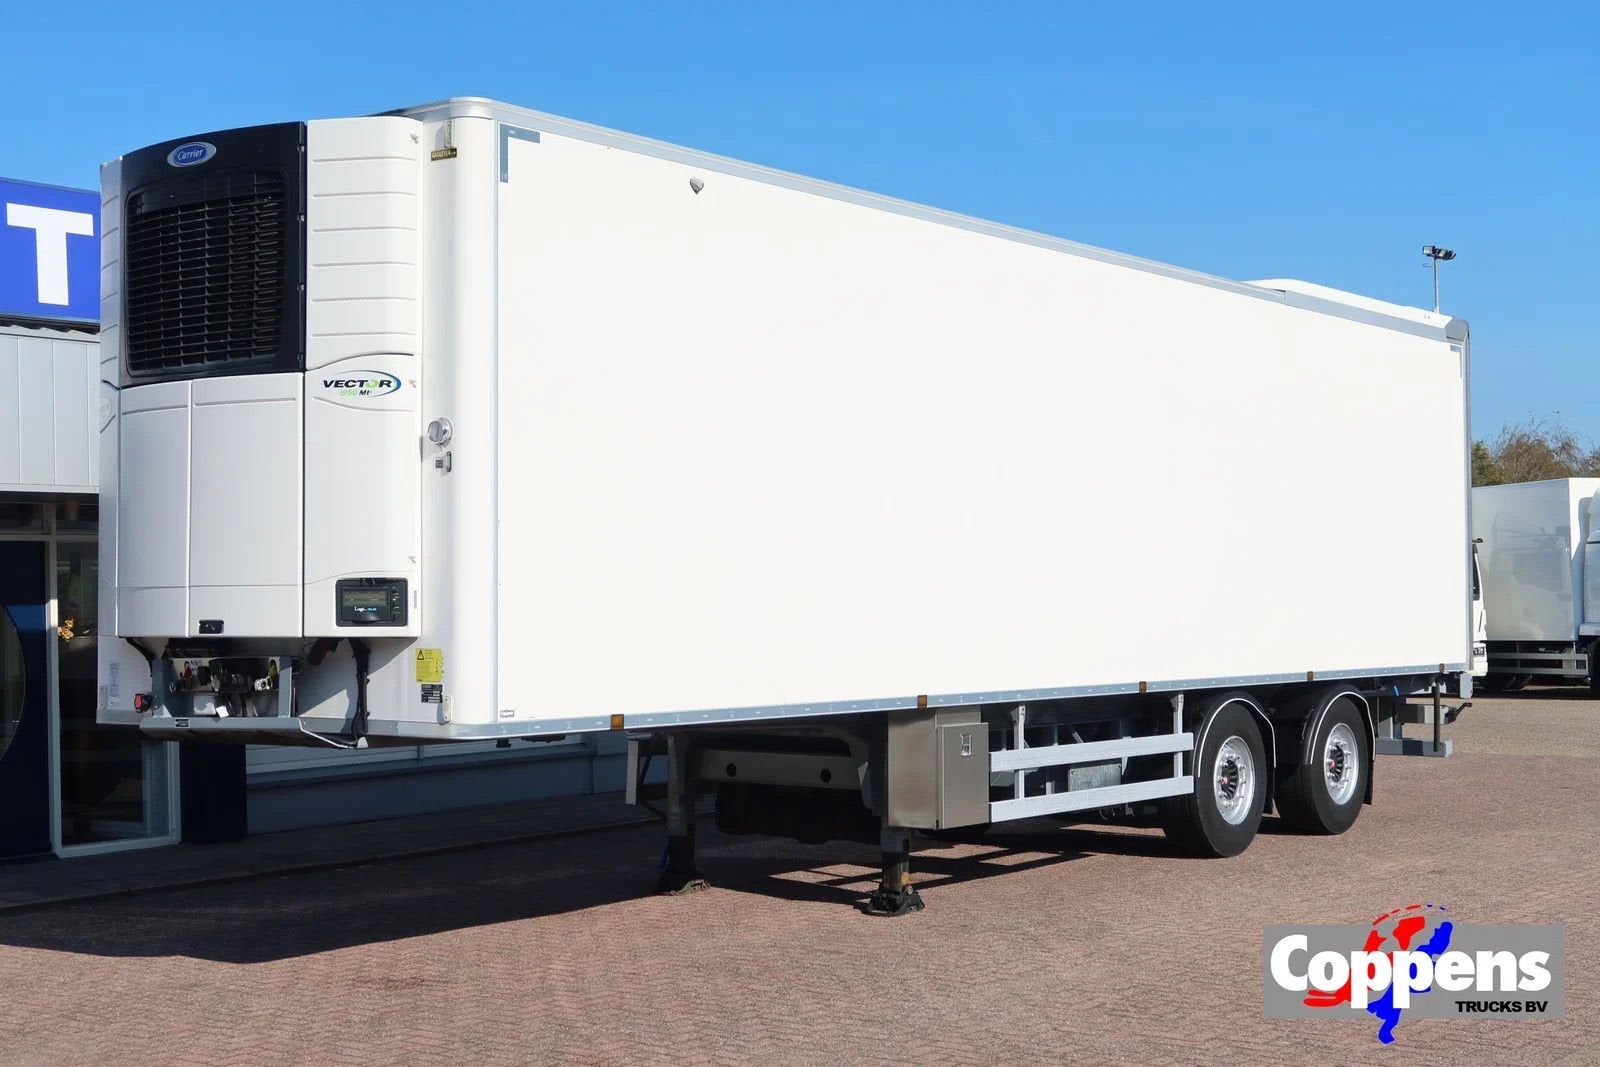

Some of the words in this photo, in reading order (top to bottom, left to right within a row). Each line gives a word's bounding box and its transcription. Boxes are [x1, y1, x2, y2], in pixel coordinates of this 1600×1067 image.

[177, 149, 204, 161] Carrier
[6, 202, 94, 306] T
[323, 379, 392, 388] VECTOR
